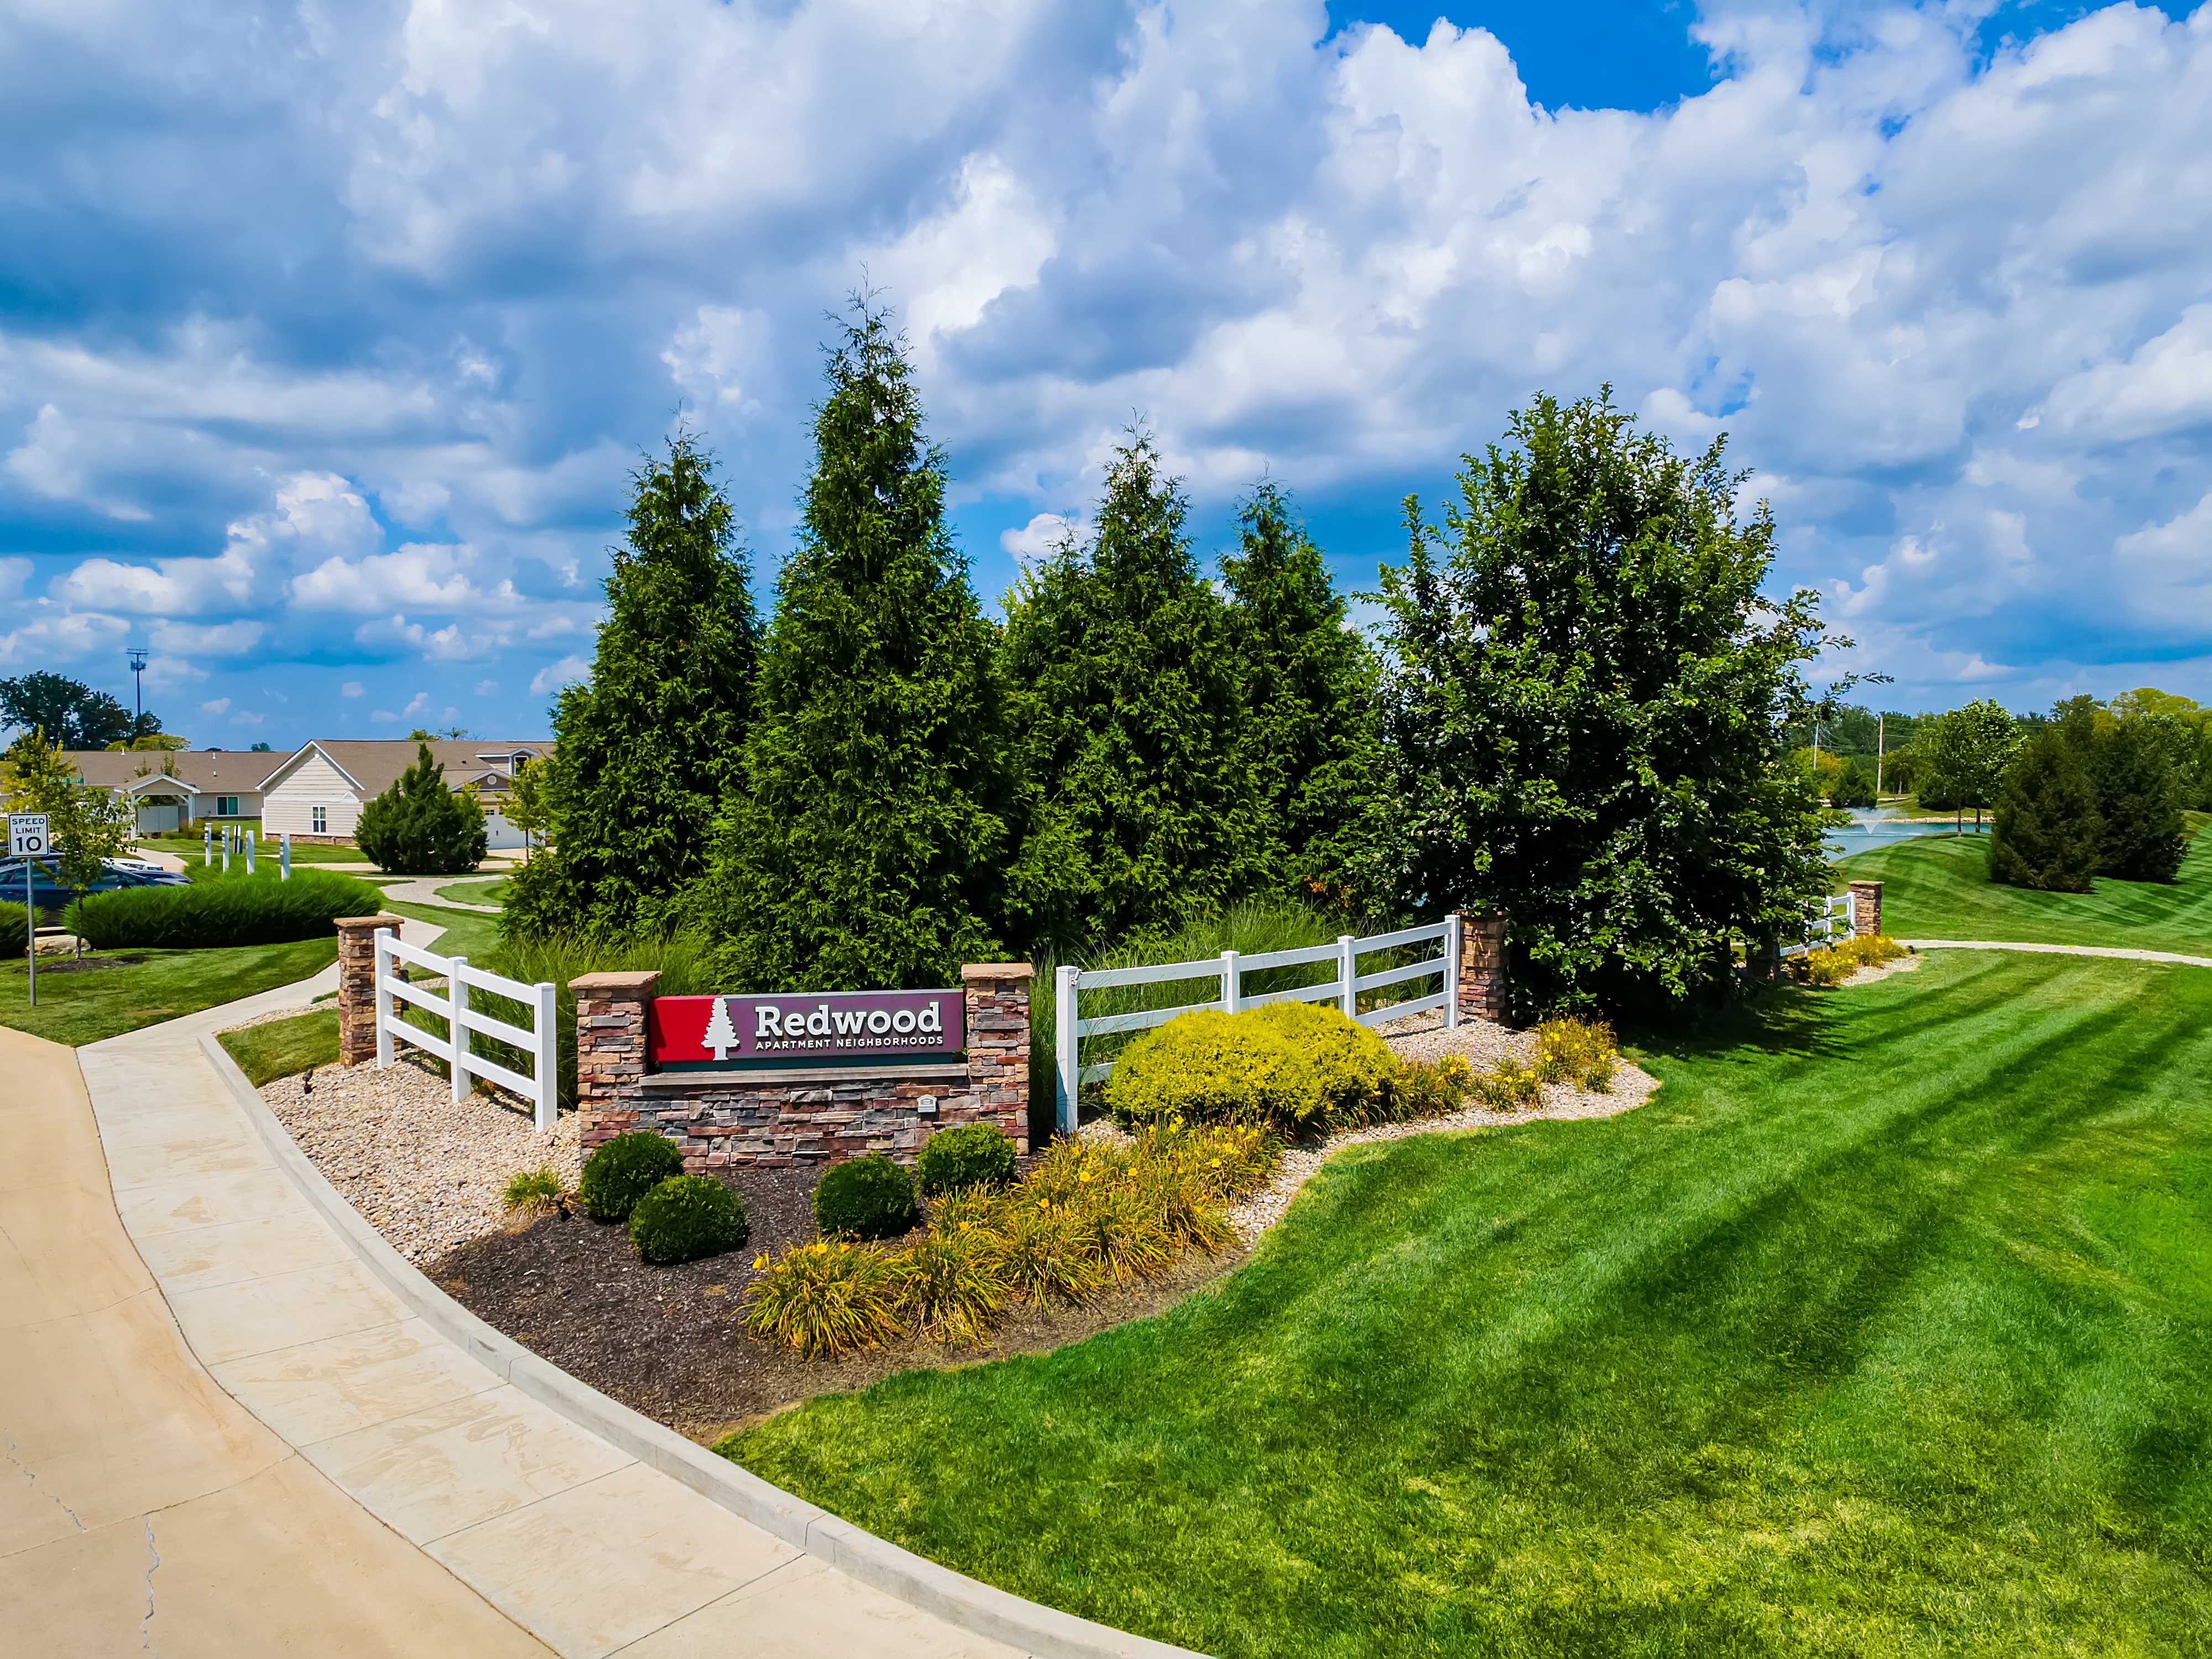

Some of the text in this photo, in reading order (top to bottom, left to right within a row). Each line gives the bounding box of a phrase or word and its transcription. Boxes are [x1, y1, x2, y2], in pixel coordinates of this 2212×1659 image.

[16, 836, 41, 852] 10
[755, 1001, 942, 1037] Redwood
[755, 1036, 943, 1050] APARTMENT NEIGHBORHOODS
